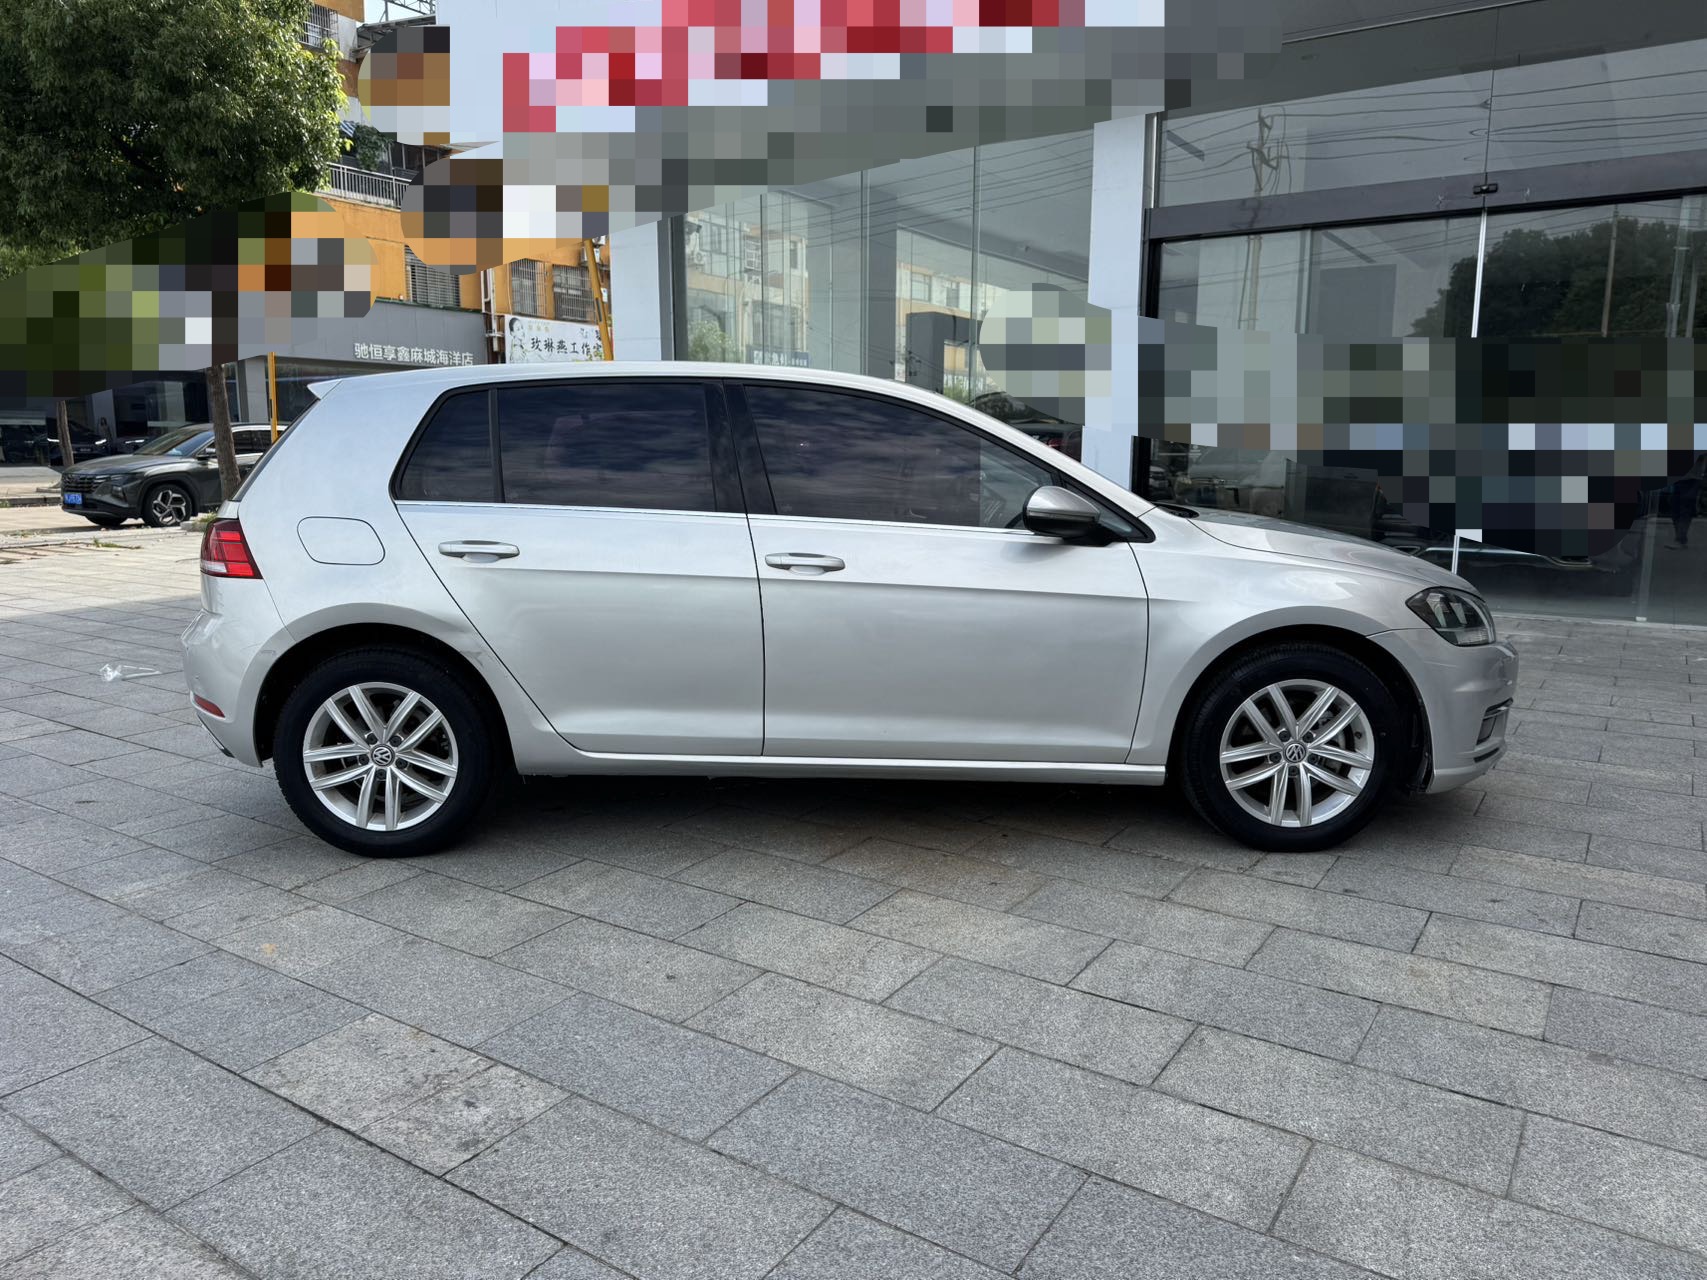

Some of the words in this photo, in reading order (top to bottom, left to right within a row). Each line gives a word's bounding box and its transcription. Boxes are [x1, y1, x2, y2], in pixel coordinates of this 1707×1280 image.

[354, 343, 474, 366] 驰恒享鑫麻城海洋店
